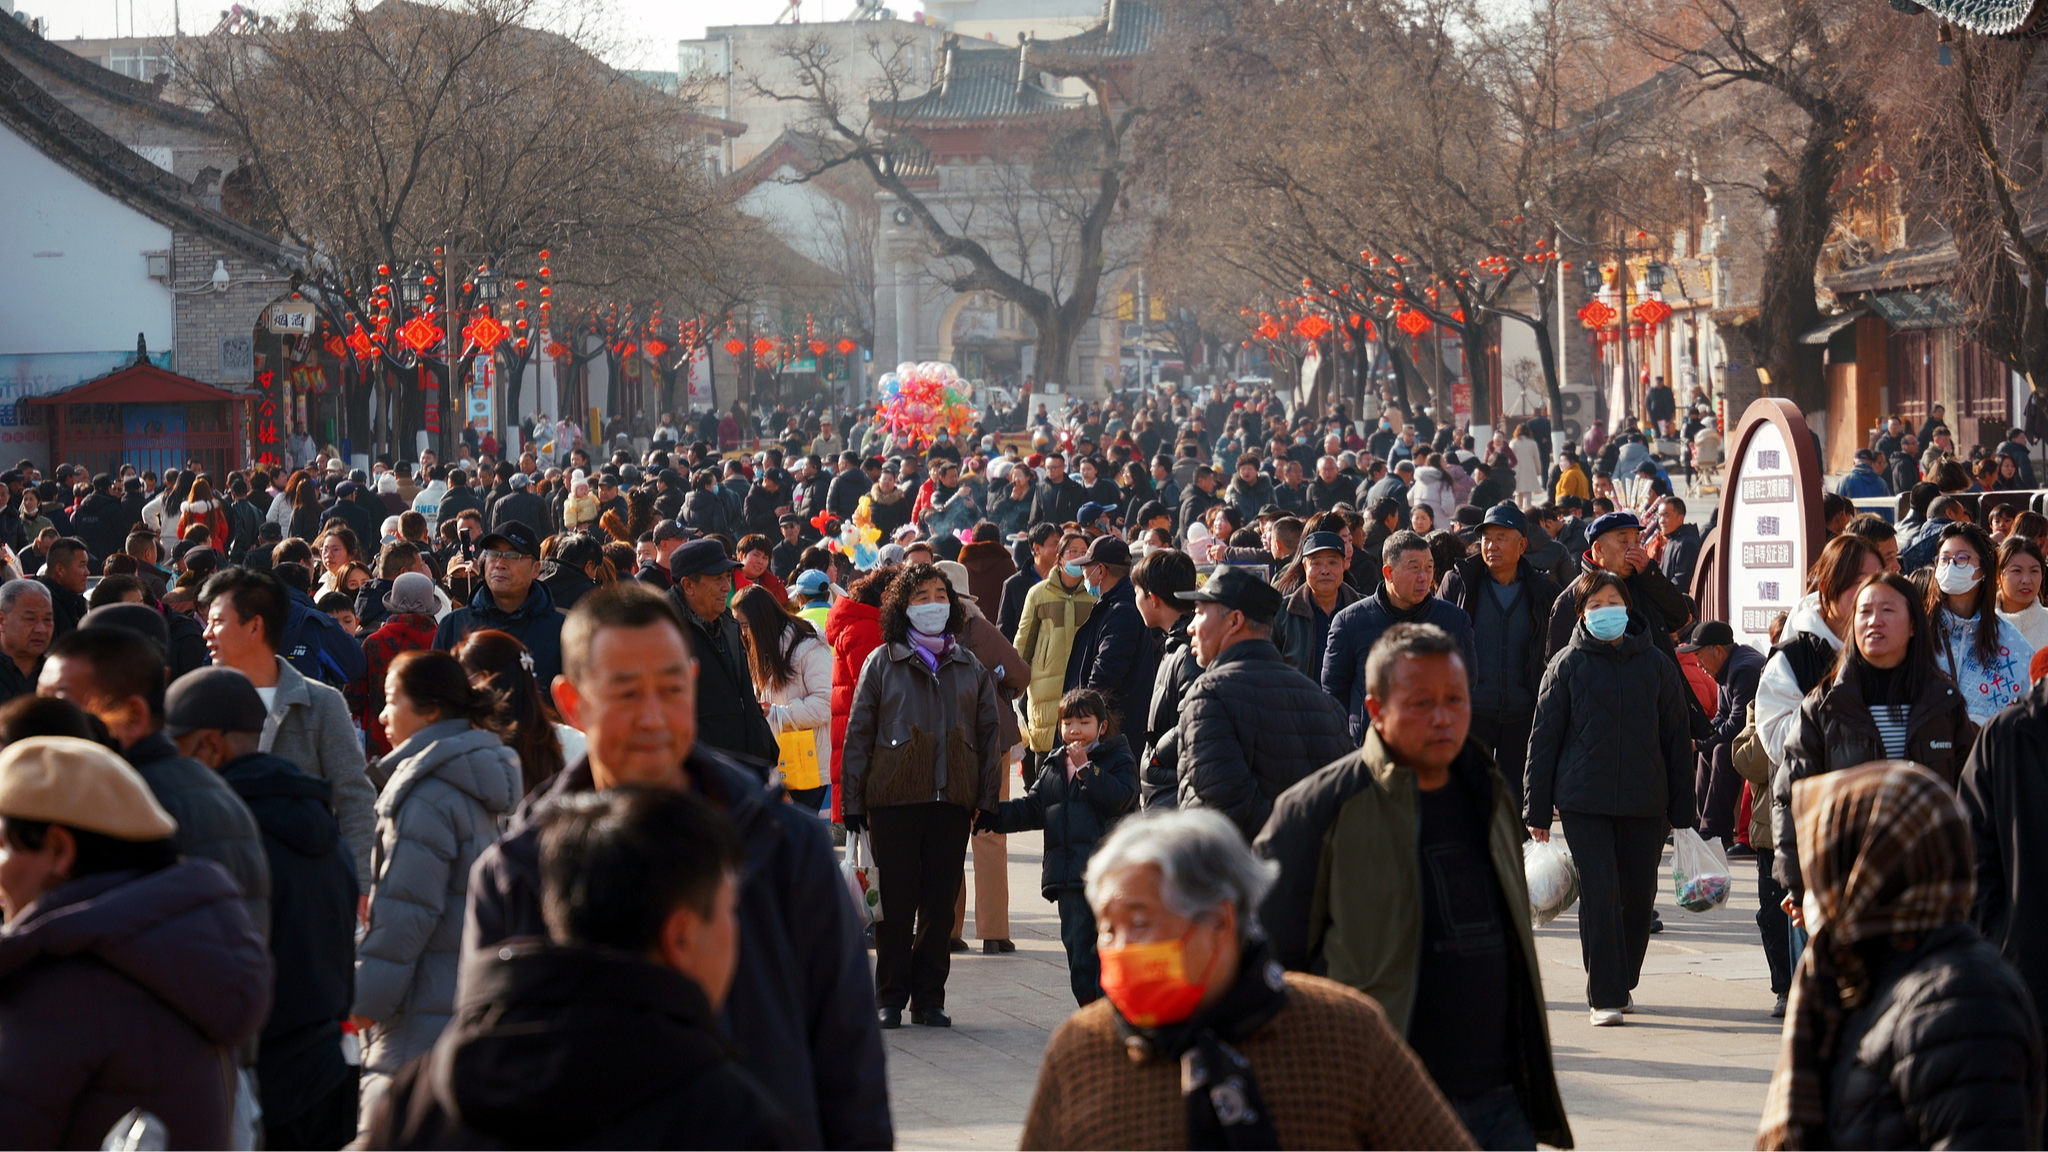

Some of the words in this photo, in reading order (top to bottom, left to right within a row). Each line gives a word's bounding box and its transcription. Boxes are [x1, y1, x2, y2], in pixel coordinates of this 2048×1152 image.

[273, 313, 305, 328] 烟酒
[1757, 515, 1780, 536] 社会层面
[1757, 581, 1779, 601] 个人层面
